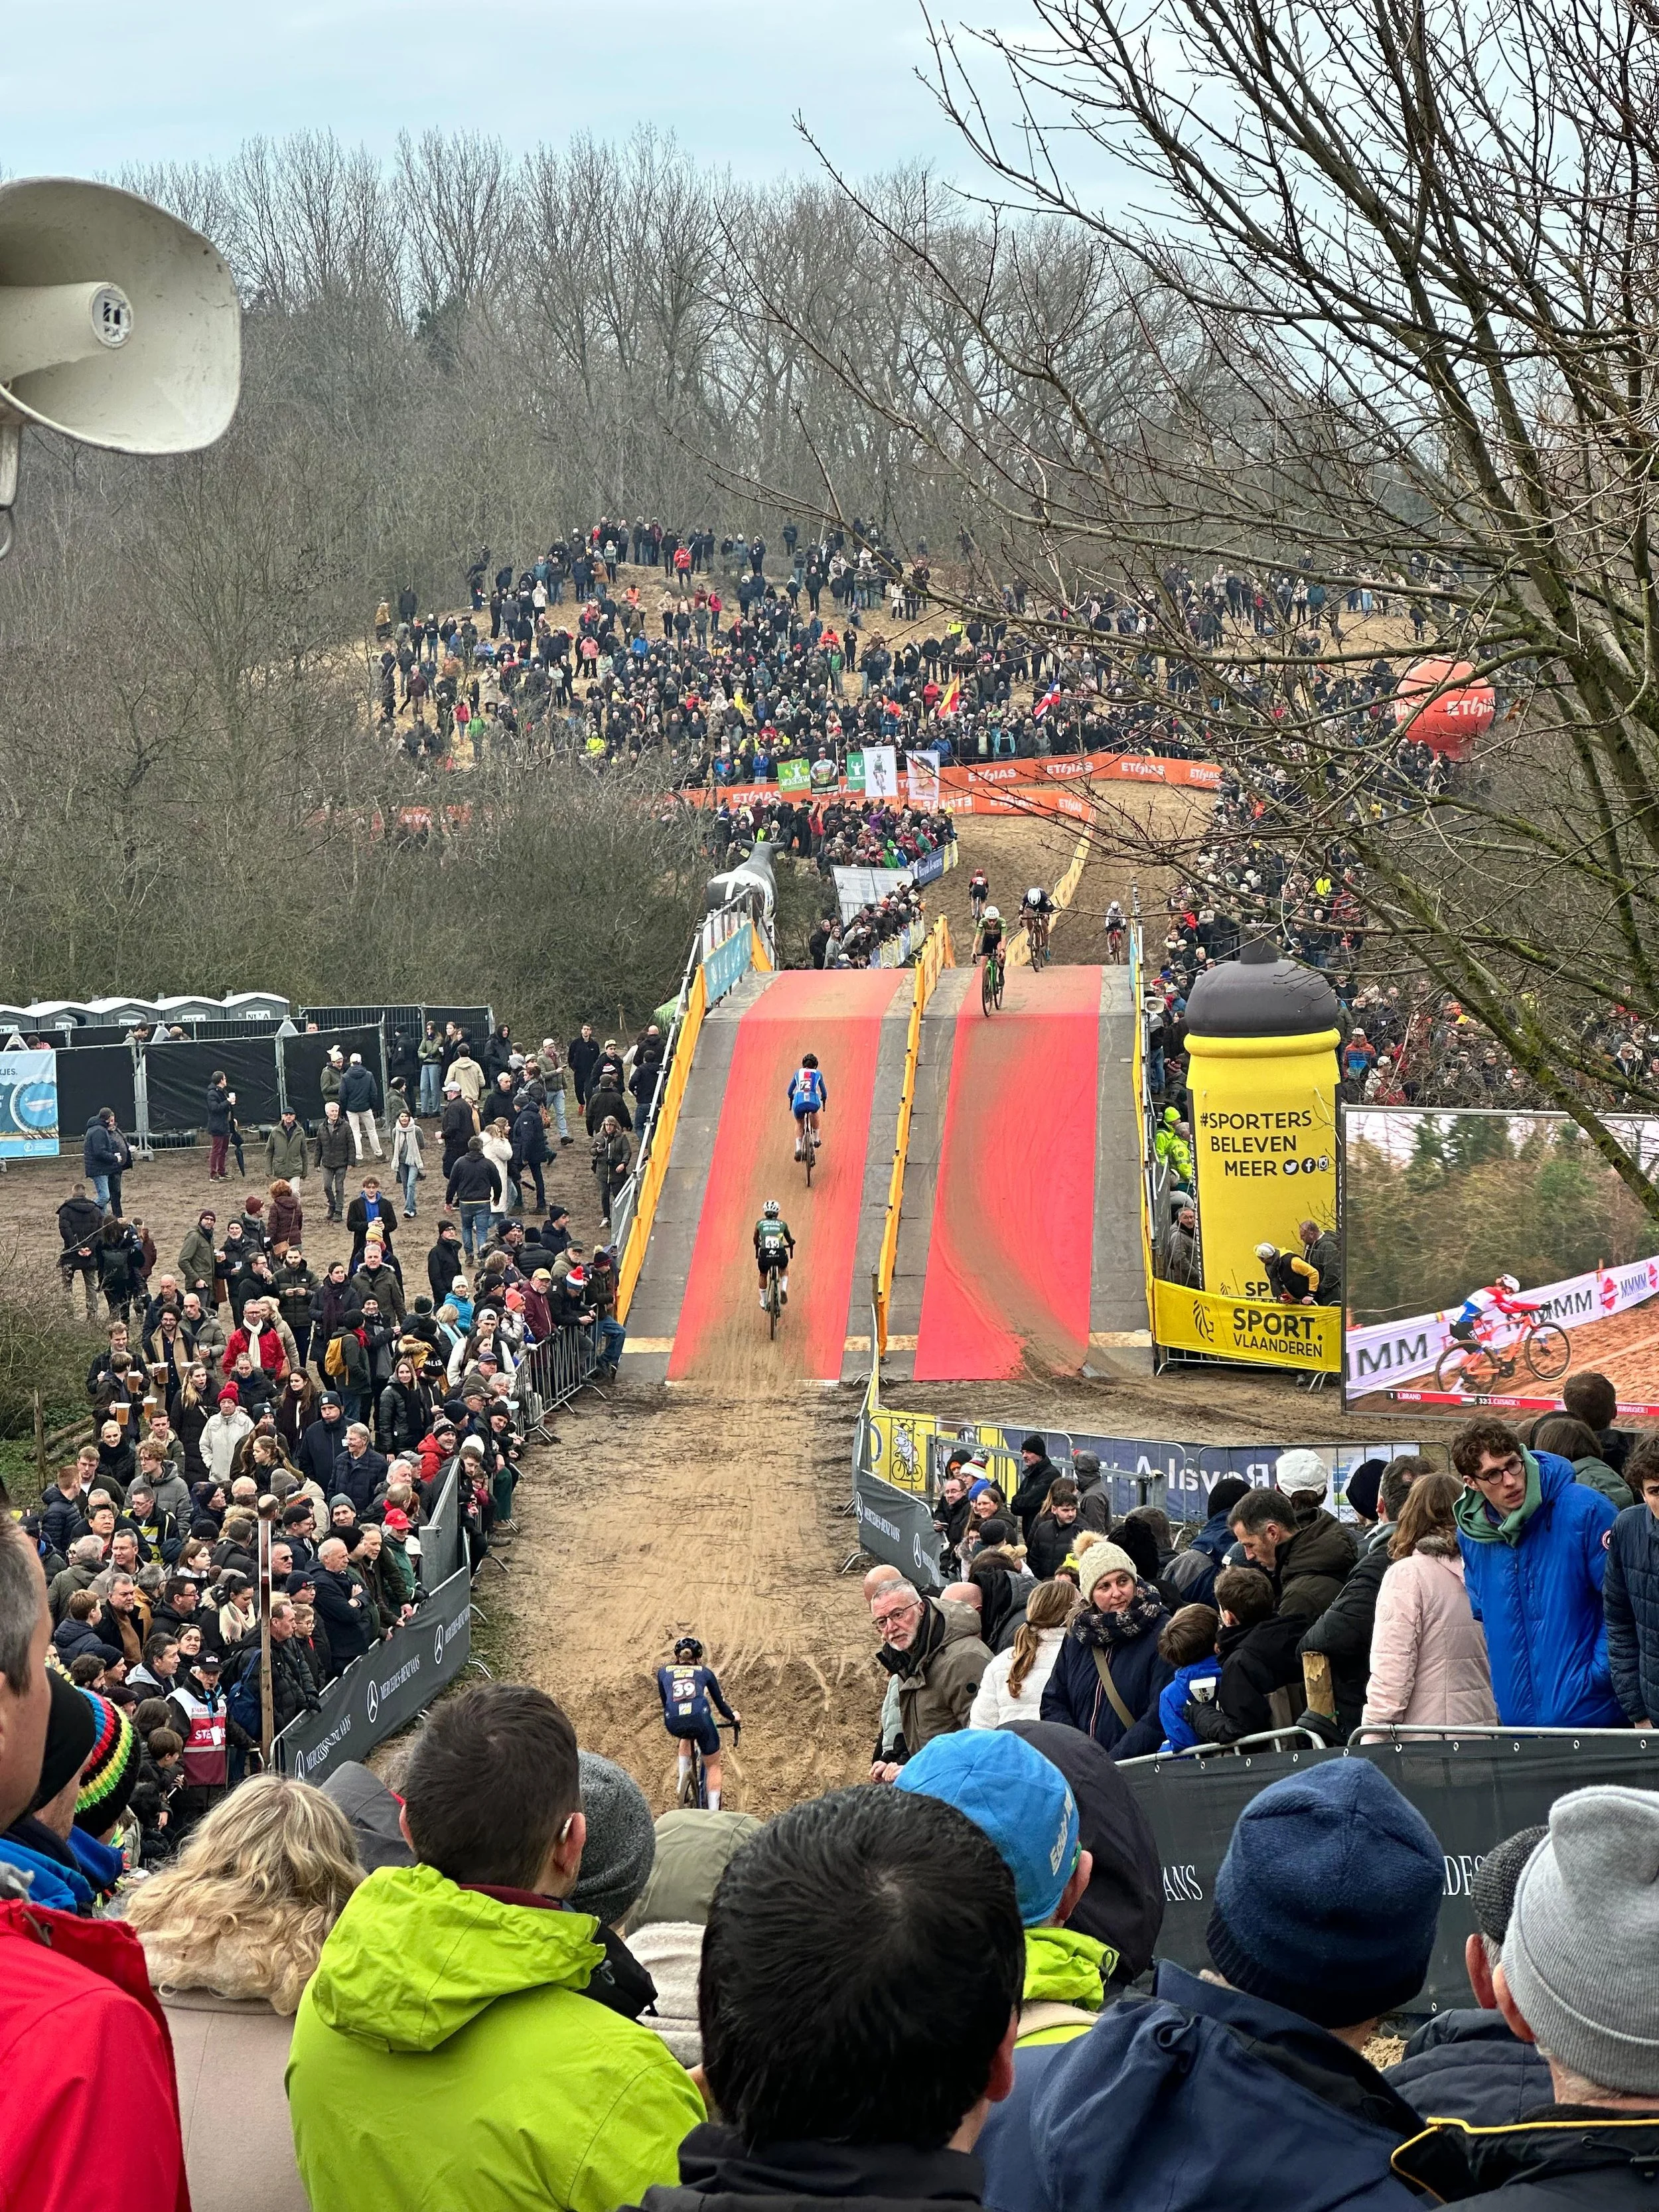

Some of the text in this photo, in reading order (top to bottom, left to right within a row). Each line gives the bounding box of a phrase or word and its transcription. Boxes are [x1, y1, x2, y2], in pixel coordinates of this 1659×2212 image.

[1200, 1110, 1313, 1130] #SPORTERS
[1210, 1135, 1297, 1153] BELEVEN
[1224, 1159, 1278, 1177] MEER
[1233, 1307, 1323, 1341] SPORT.
[1233, 1332, 1323, 1358] VLAANDEREN
[673, 1682, 695, 1698] 39
